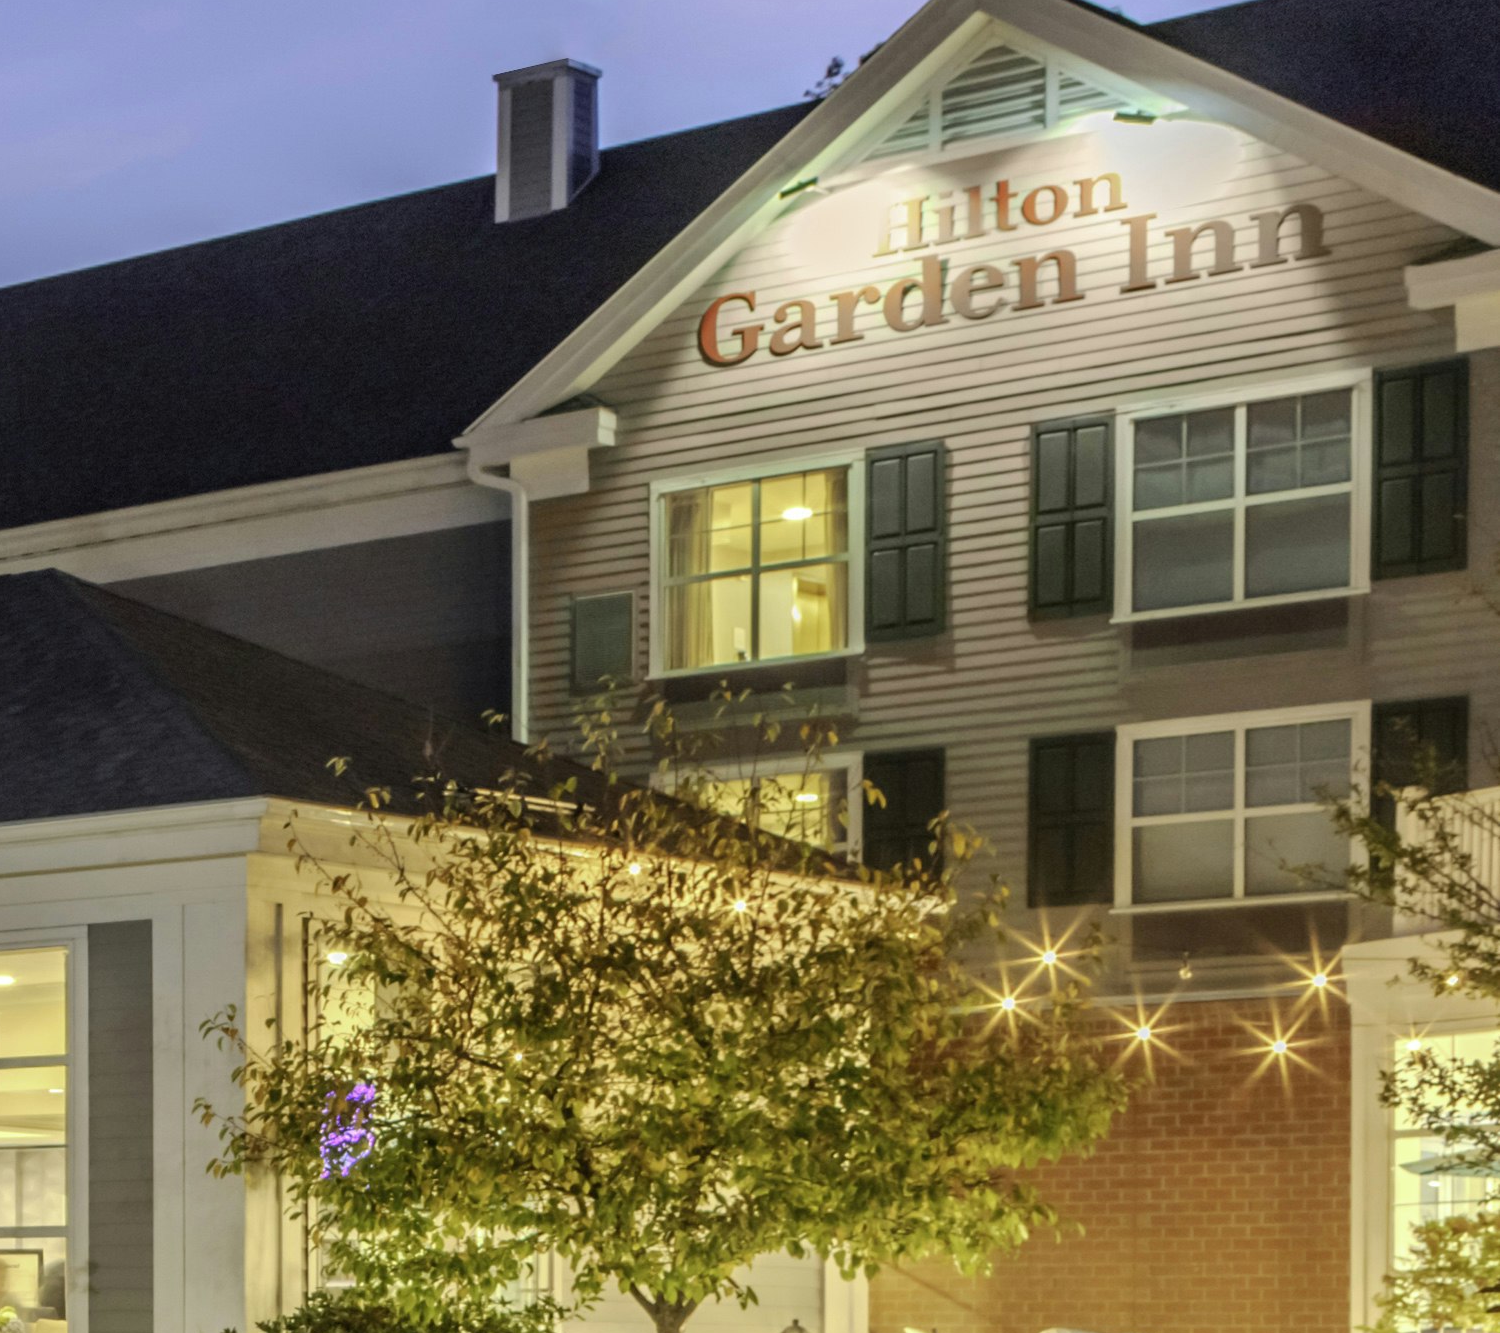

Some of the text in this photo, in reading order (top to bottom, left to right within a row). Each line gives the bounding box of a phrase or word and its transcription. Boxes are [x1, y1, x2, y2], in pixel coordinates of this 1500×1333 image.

[871, 172, 1129, 258] Hilton
[698, 199, 1332, 367] Garden Inn
